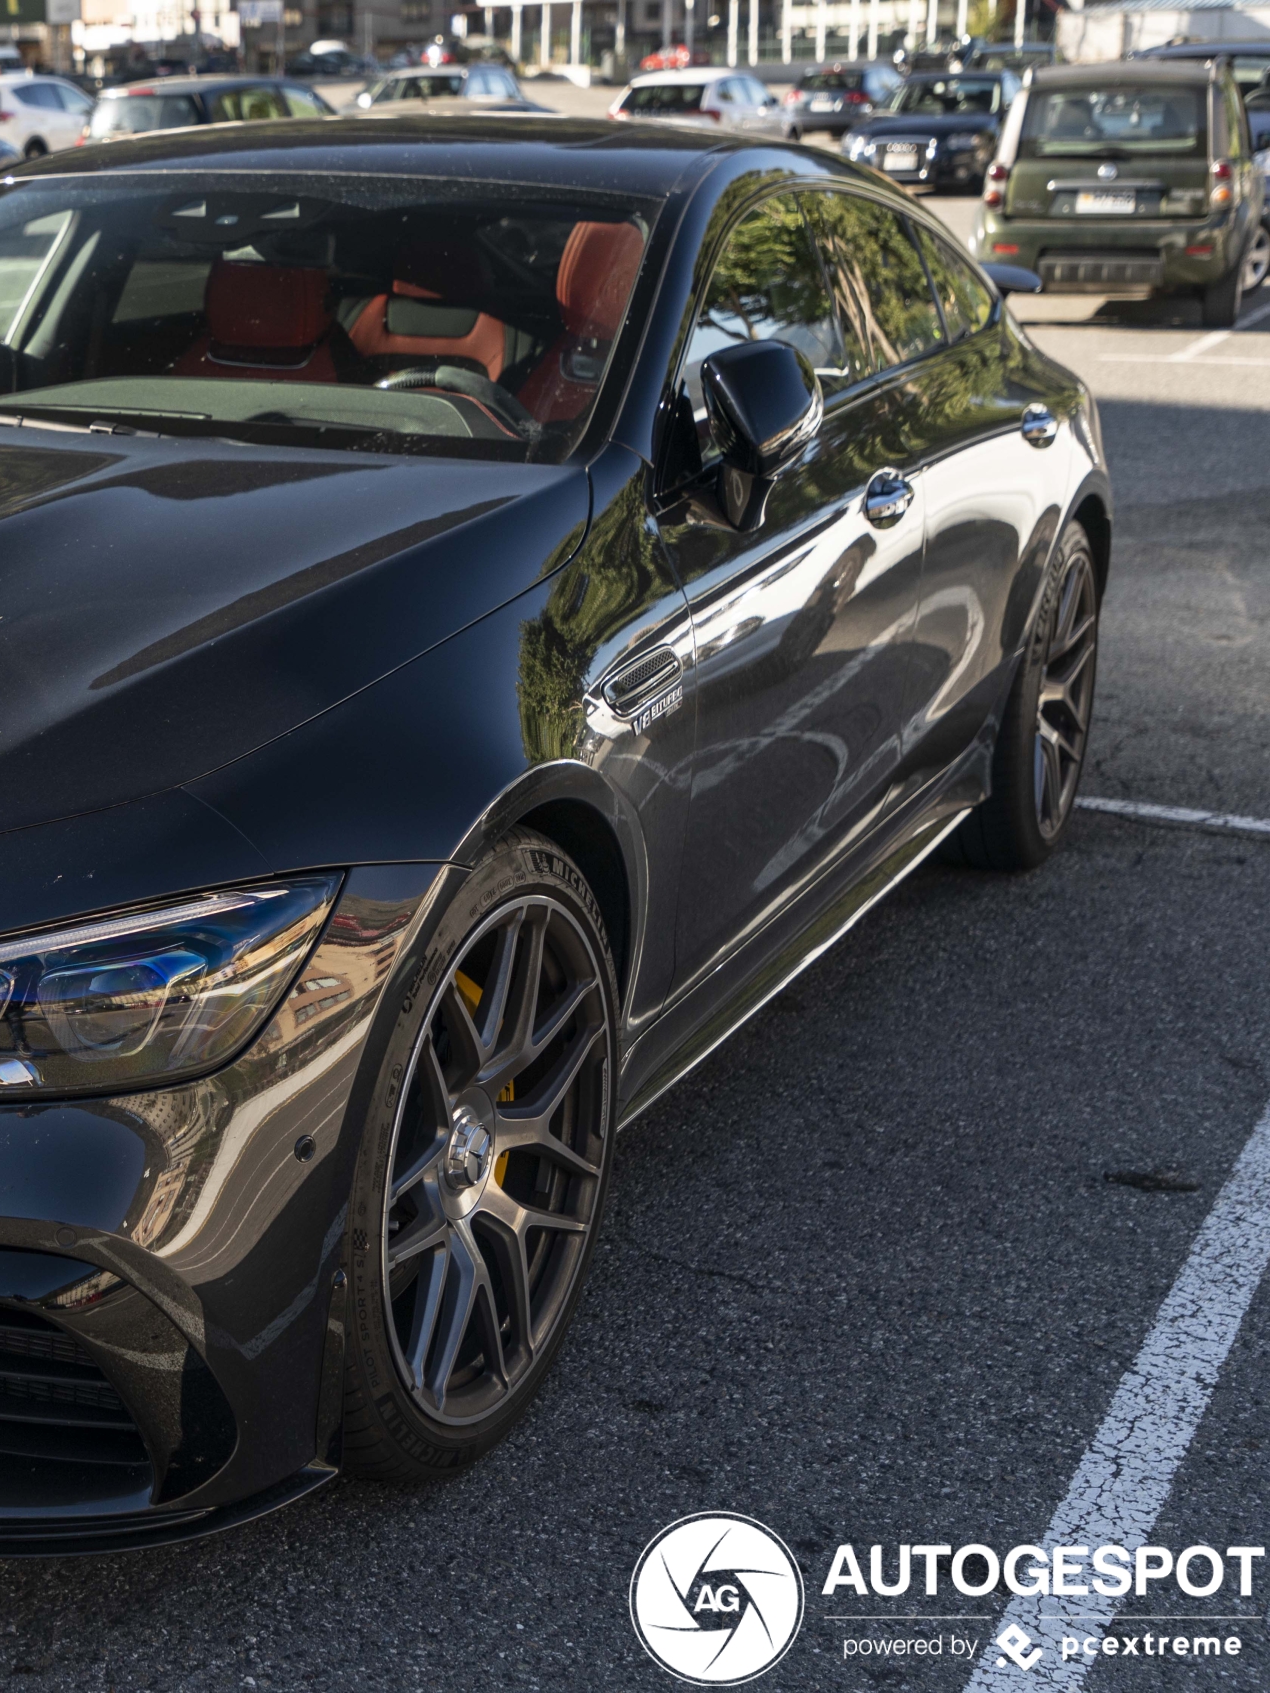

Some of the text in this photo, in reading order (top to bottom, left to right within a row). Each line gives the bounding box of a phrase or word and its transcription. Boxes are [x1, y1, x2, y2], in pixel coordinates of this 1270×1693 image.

[552, 857, 607, 946] MICHELIN
[357, 1285, 370, 1341] SPORT
[364, 1348, 380, 1389] PILOT
